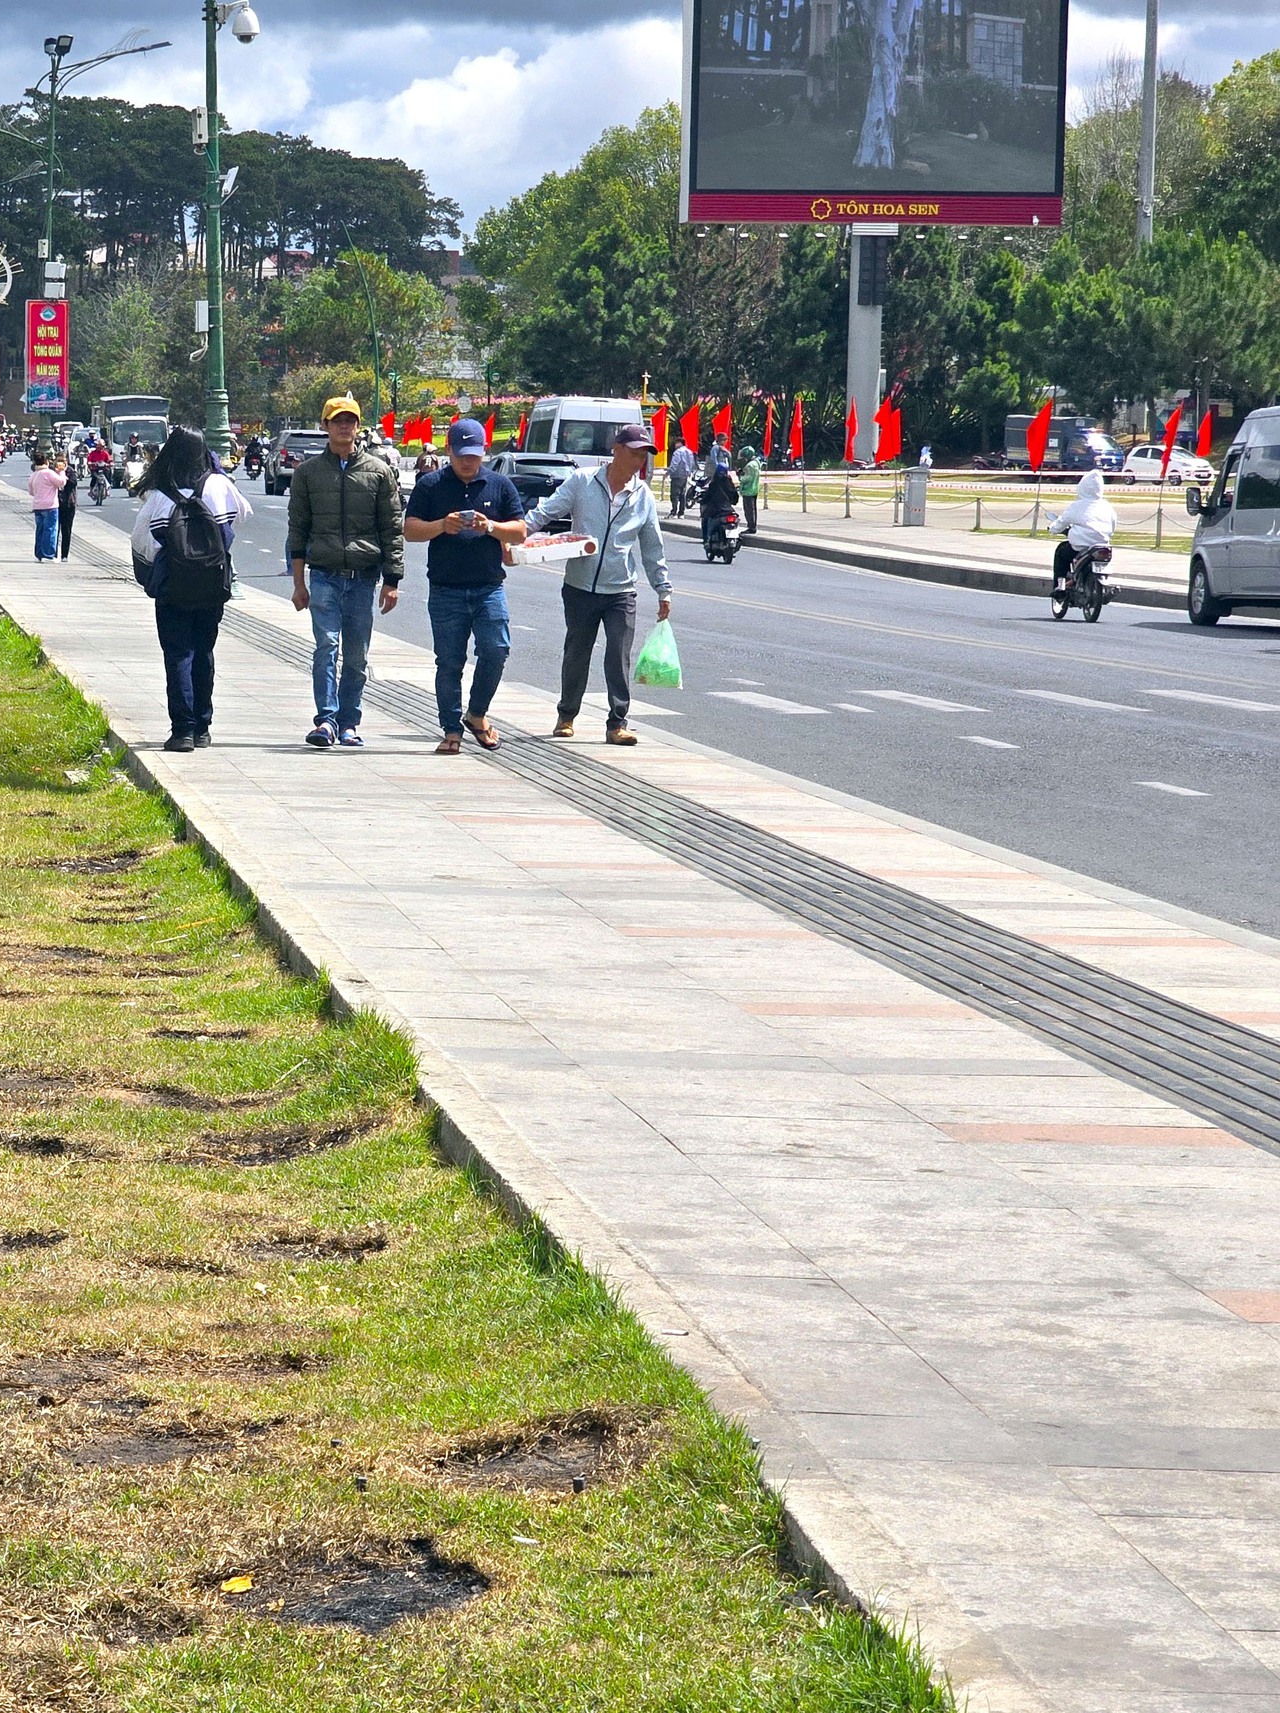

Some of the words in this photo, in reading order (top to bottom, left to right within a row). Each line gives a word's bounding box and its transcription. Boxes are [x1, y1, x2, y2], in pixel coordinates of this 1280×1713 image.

[836, 200, 869, 215] TÔN
[872, 203, 905, 215] HOA
[908, 203, 940, 215] SEN
[37, 324, 47, 341] HỘI
[47, 326, 59, 341] TRẠI
[36, 362, 47, 376] NĂM
[48, 365, 60, 376] 2025
